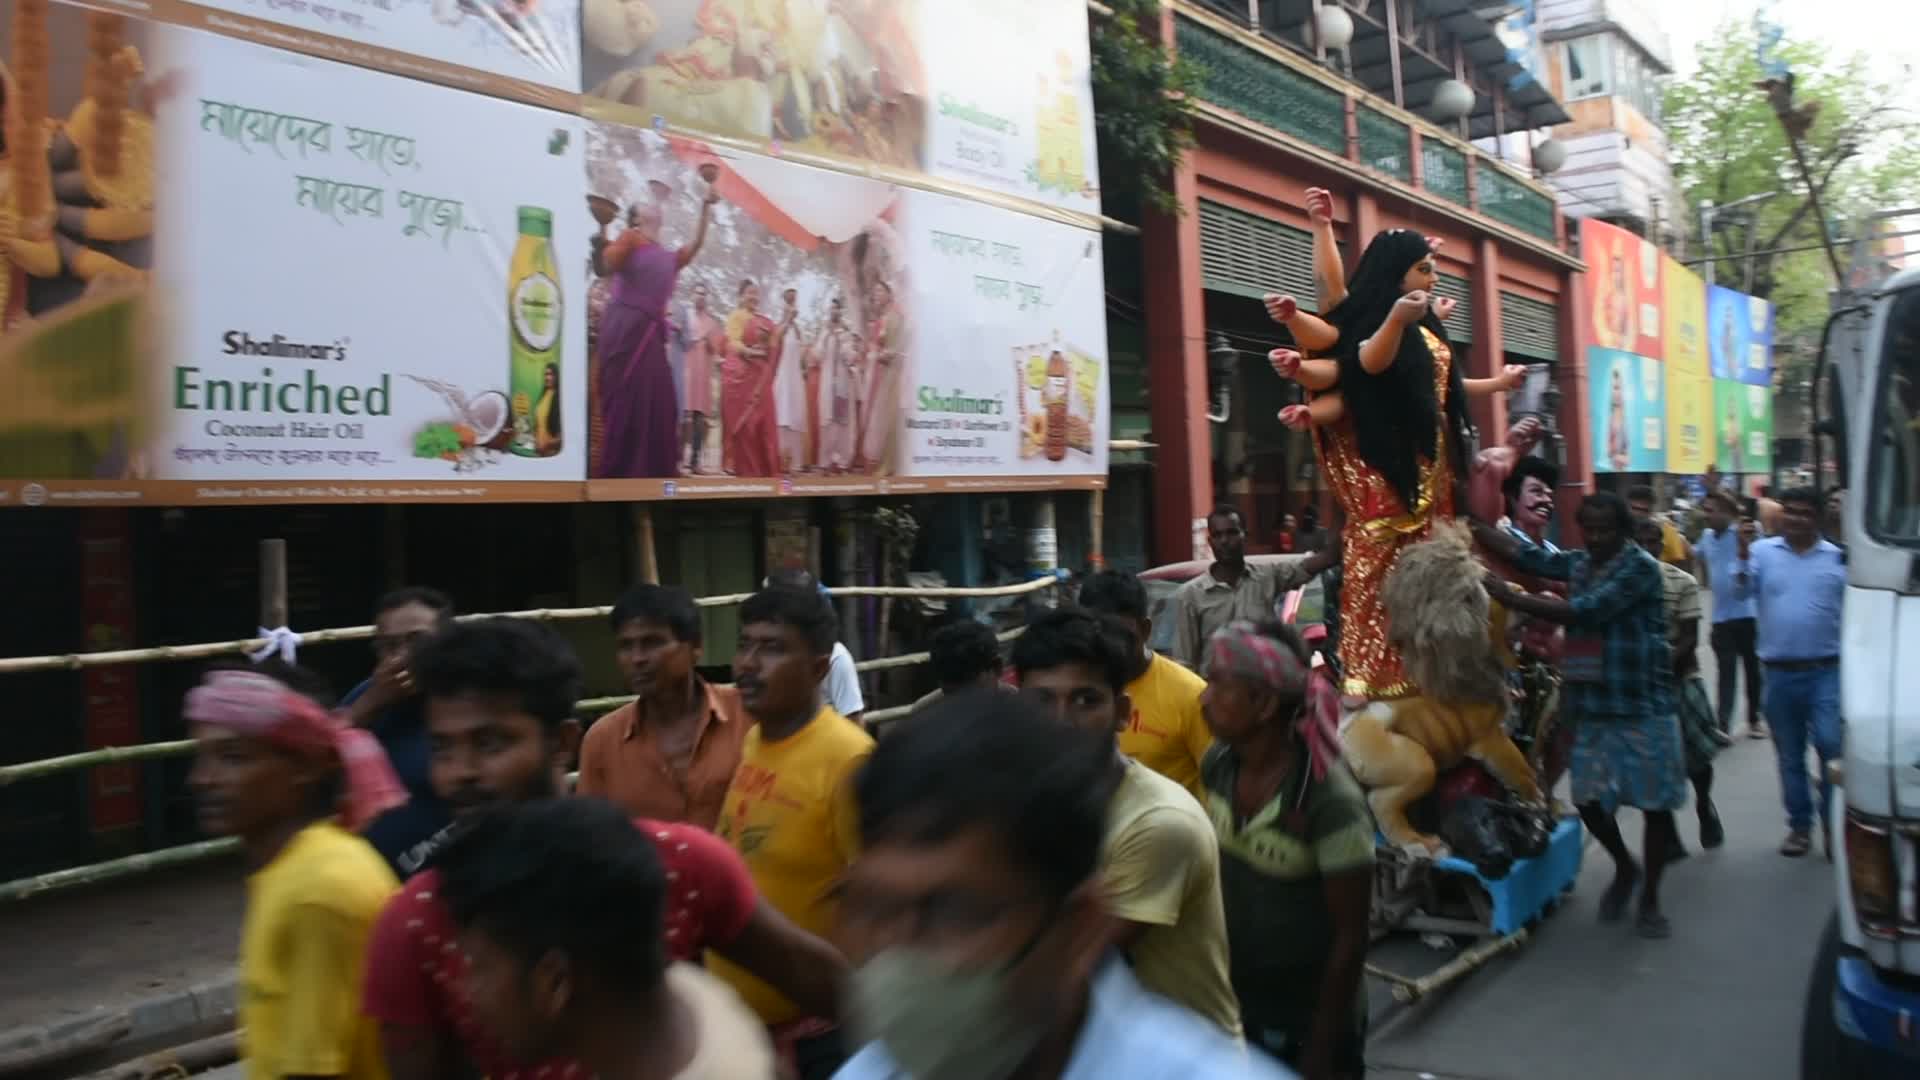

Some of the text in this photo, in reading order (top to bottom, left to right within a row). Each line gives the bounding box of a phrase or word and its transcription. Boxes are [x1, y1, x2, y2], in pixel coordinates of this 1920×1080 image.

[222, 330, 348, 361] Shalimar's
[174, 366, 391, 416] Enriched
[205, 419, 365, 439] Coconut Hair Oil
